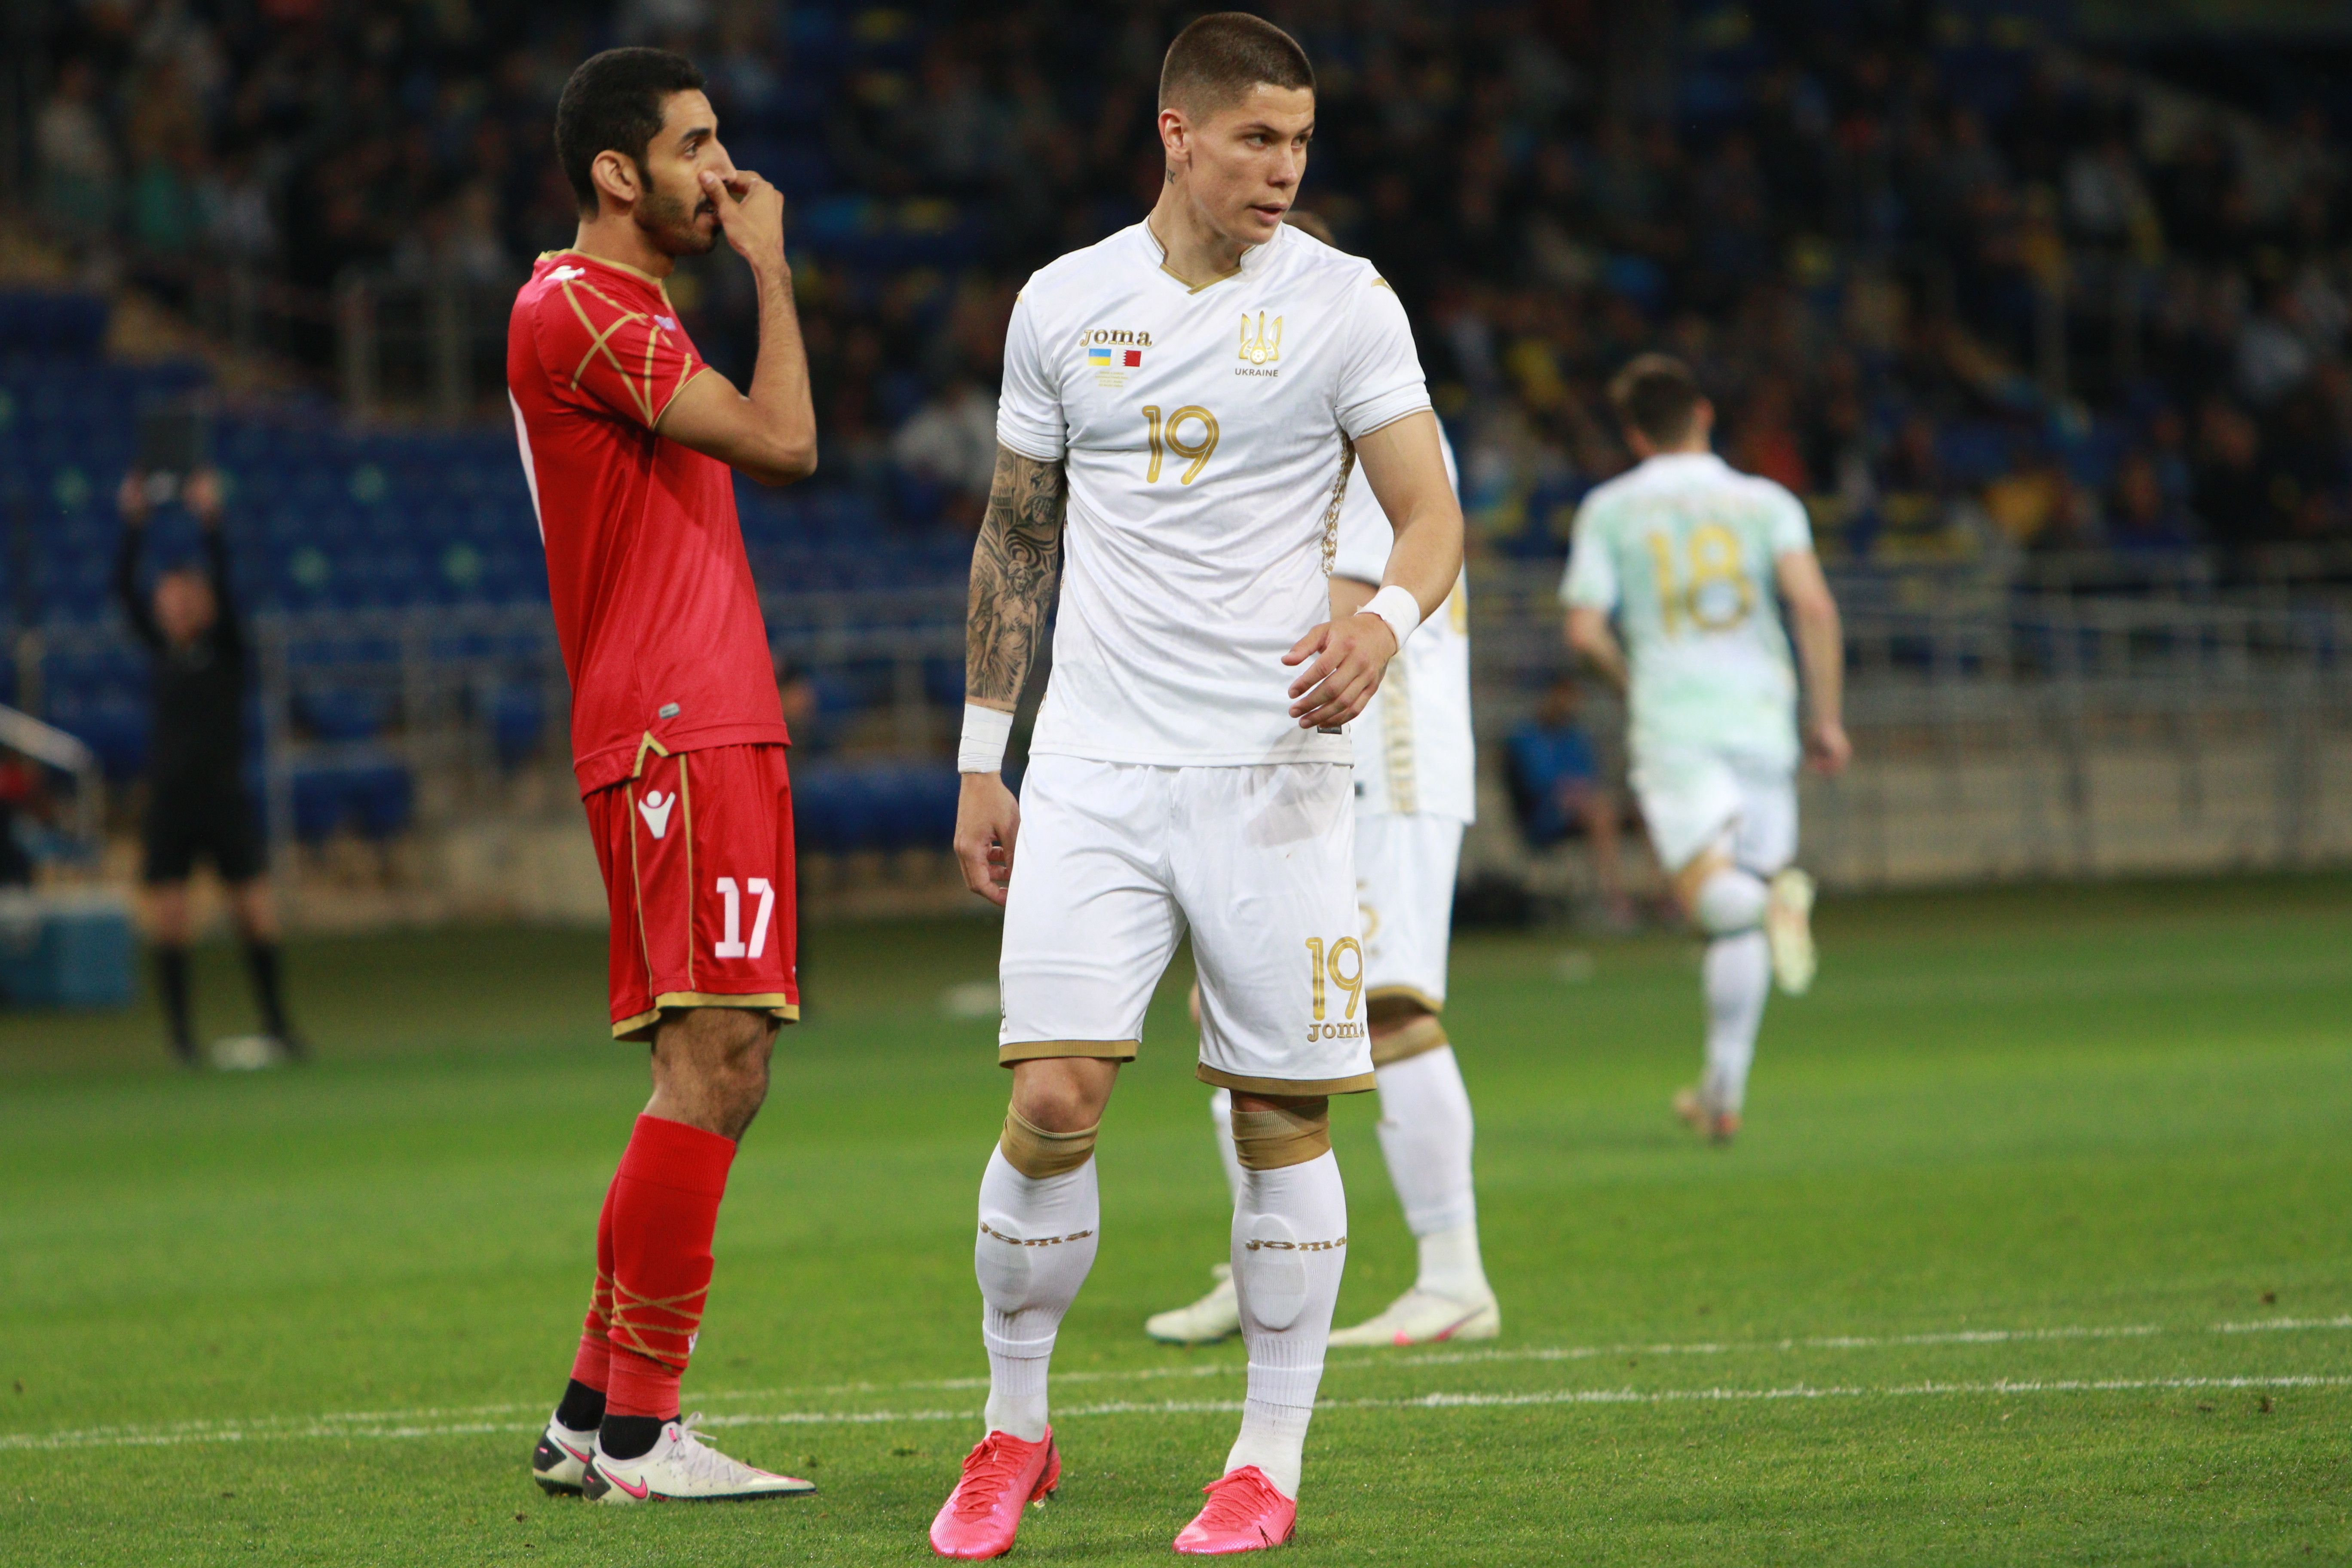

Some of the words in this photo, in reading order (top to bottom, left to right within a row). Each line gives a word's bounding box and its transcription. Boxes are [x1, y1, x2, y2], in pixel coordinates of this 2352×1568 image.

[1235, 368, 1279, 377] UKRAINE
[1142, 405, 1220, 485] 19
[1646, 524, 1756, 637] 18
[715, 877, 775, 959] 17
[1305, 937, 1363, 1021] 19
